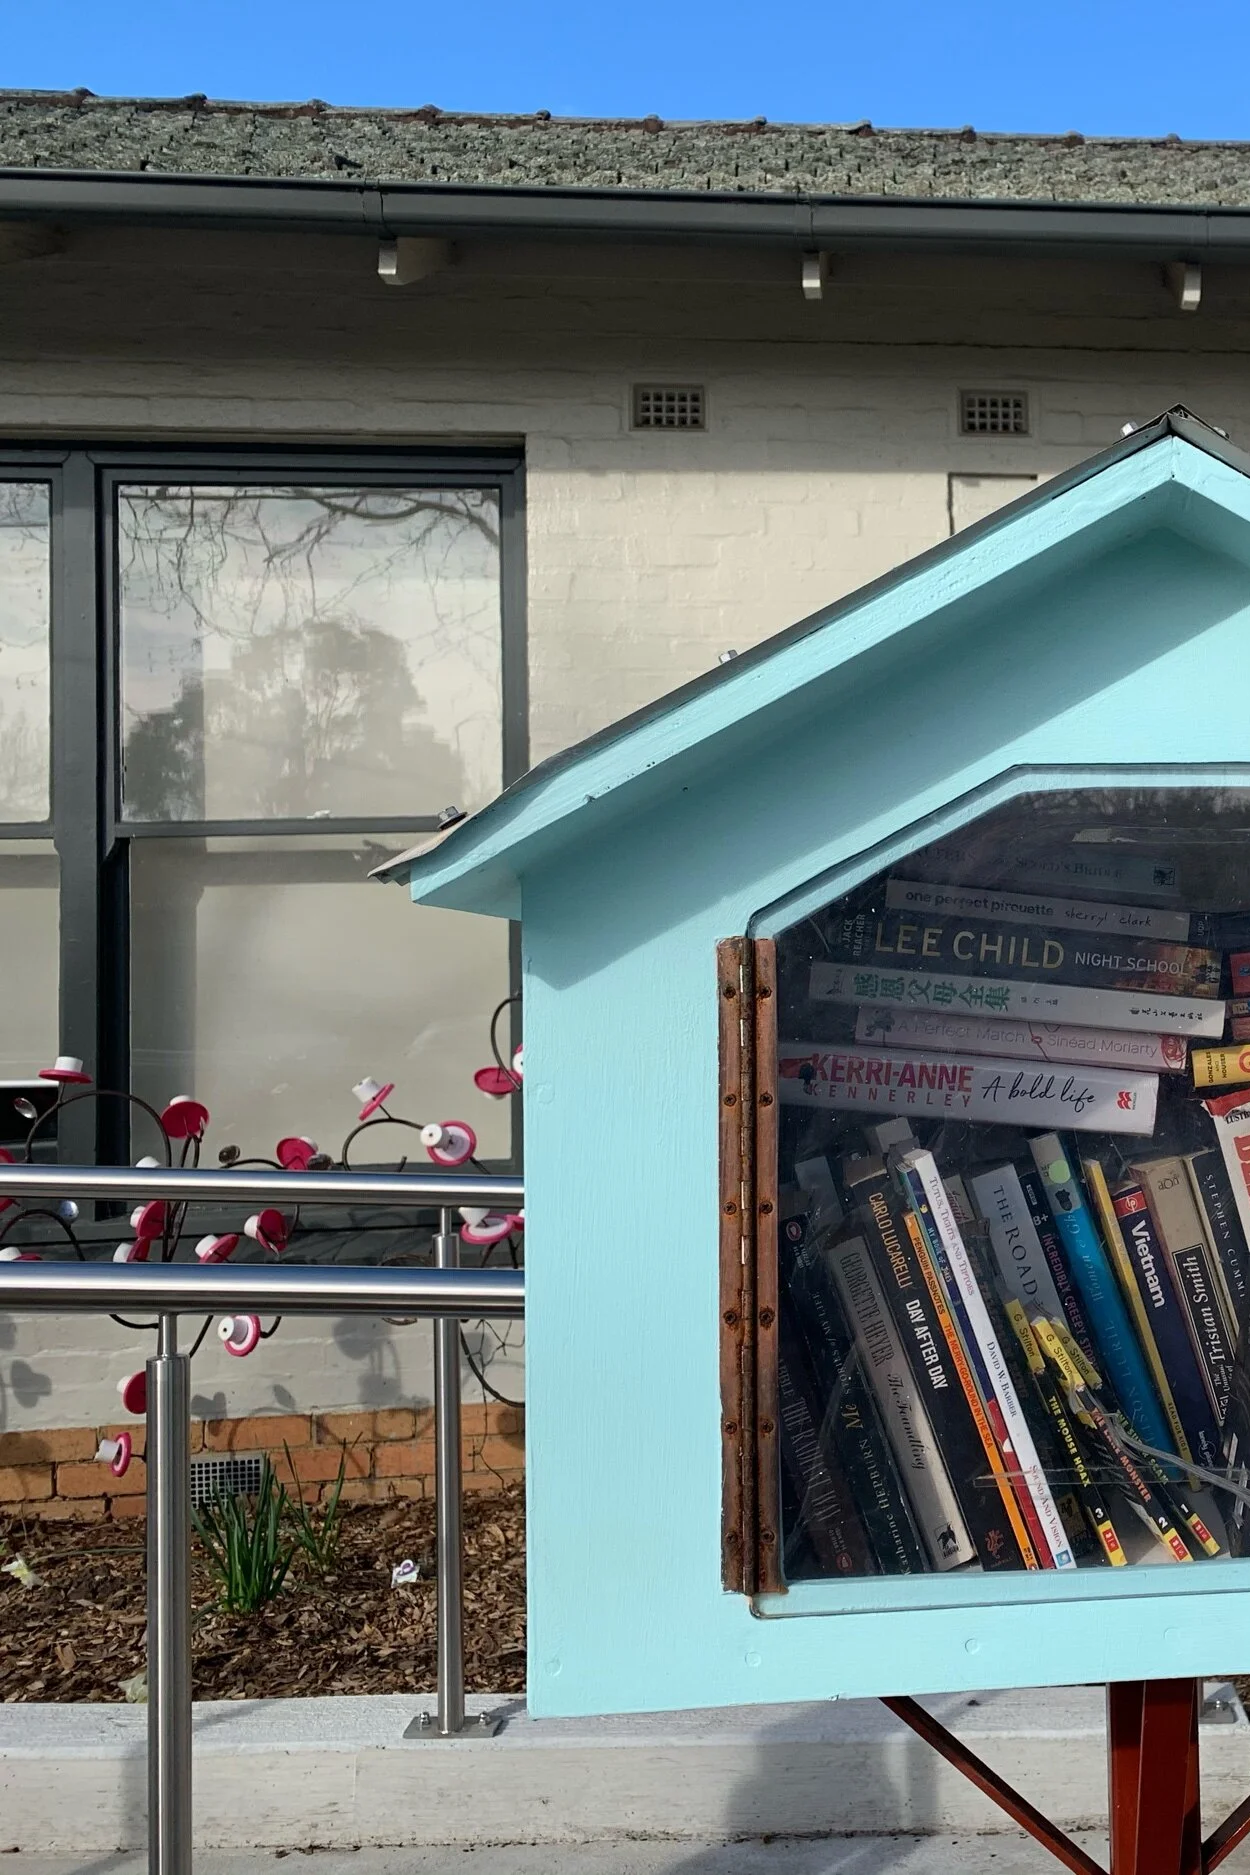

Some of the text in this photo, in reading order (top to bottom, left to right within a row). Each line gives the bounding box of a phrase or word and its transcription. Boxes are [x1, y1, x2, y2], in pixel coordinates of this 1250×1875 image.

[906, 889, 931, 903] one
[935, 892, 988, 912] perfect
[991, 899, 1054, 917] pirouette
[1119, 914, 1152, 928] clark
[844, 918, 853, 942] JACK
[853, 914, 866, 957] REACHER
[875, 922, 1188, 976] LEE CHILD NIGHT SCHOOL
[976, 1026, 1025, 1043] Match
[1101, 1039, 1158, 1057] Moriarty
[812, 1052, 975, 1094] KERRI-ANNE
[1206, 1051, 1214, 1083] GONZALES
[809, 1083, 971, 1108] KENNERLEY
[982, 1071, 1096, 1113] A bold life
[926, 1176, 947, 1209] TUTUS,
[939, 1209, 958, 1241] TIGHTS
[990, 1184, 1039, 1296] THE ROAD
[1203, 1173, 1249, 1299] STEPHEN CUMMI
[950, 1240, 964, 1261] AND
[1130, 1219, 1168, 1310] Vietnam
[867, 1191, 949, 1392] CARLO LUCARELLI DAY AFTER DAY
[956, 1260, 977, 1297] TIPTOES
[1075, 1251, 1107, 1303] Women
[1183, 1255, 1209, 1306] Smith
[836, 1251, 881, 1323] GEORGETTE
[859, 1318, 897, 1368] HEYER
[1039, 1231, 1100, 1374] INCREDIBLY CREEPY STORI
[911, 1236, 994, 1449] PENGUIN PASSNOTES THE MERRY-GO-ROUND IN THE SEA
[1017, 1326, 1037, 1358] Stilton
[1193, 1305, 1228, 1365] Tristan
[985, 1340, 1003, 1370] DAVID
[1044, 1332, 1075, 1378] G. Stilton
[1068, 1346, 1090, 1377] Stilton
[995, 1369, 1007, 1383] W.
[838, 1401, 865, 1433] Me
[999, 1382, 1019, 1418] BARBER
[1045, 1394, 1095, 1489] THE MOUSE HOAX
[1172, 1420, 1182, 1435] FOR
[1177, 1435, 1188, 1452] KIDS
[1028, 1464, 1047, 1496] SOUND
[1117, 1453, 1153, 1505] MONSTER
[1147, 1456, 1170, 1487] SCAM
[1039, 1495, 1055, 1517] AND
[1095, 1508, 1104, 1518] 3
[1158, 1517, 1169, 1528] 2
[1181, 1504, 1189, 1513] 1
[1047, 1517, 1066, 1548] VISION
